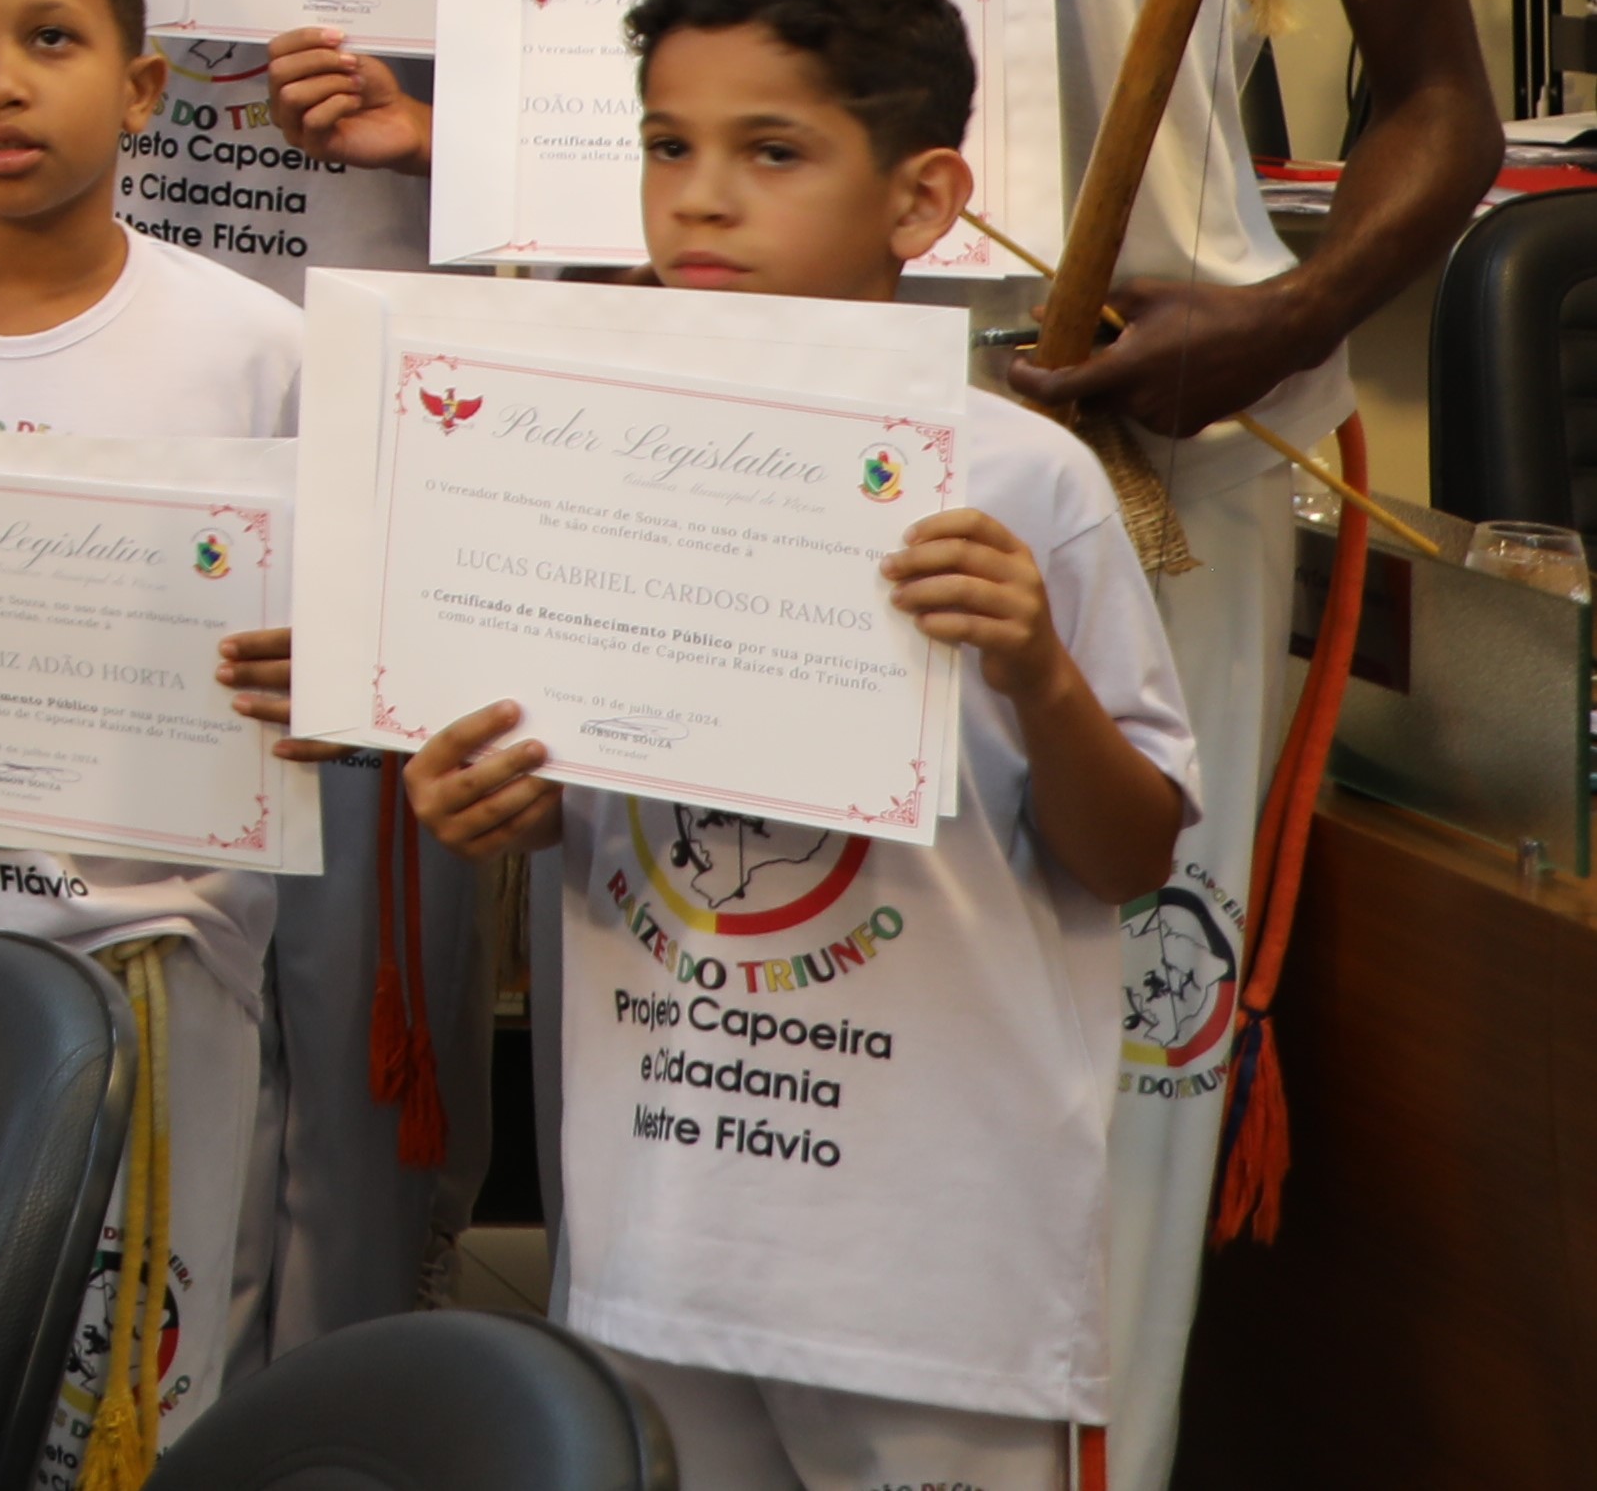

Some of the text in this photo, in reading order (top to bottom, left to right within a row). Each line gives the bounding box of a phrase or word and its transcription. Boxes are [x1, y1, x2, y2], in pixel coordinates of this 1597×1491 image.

[171, 100, 218, 130] DO
[522, 93, 584, 114] JOÃO
[121, 174, 306, 214] e Cidadania
[213, 223, 307, 258] Flávio
[492, 404, 829, 484] Poder Legislativo
[425, 479, 436, 490] O
[440, 482, 498, 500] Vereador
[503, 491, 551, 509] Robson
[556, 500, 609, 517] Alencar
[613, 508, 630, 520] de
[636, 511, 681, 530] Souza,
[688, 522, 706, 532] no
[711, 526, 737, 537] uso
[742, 528, 768, 542] das
[772, 535, 860, 556] atribuições
[539, 513, 560, 527] lhe
[565, 518, 588, 532] são
[592, 525, 672, 546] conferidas,
[677, 538, 740, 556] concede
[457, 548, 872, 631] LUCAS GABRIEL CARDOSO RAMOS
[433, 589, 512, 613] Certificado
[516, 603, 533, 617] de
[538, 607, 667, 639] Reconhecimento
[672, 629, 733, 650] Público
[738, 643, 766, 655] por
[772, 649, 798, 660] sua
[804, 653, 907, 677] participação
[438, 611, 475, 625] como
[479, 616, 518, 633] atleta
[523, 625, 540, 636] na
[545, 627, 627, 651] Associação
[632, 641, 650, 654] de
[656, 645, 727, 667] Capoeira
[789, 666, 810, 680] do
[28, 654, 94, 678] ADÃO
[102, 663, 185, 691] HORTA
[0, 864, 89, 900] Flávio
[607, 868, 904, 993] RAÍZES DO TRIUNFO
[615, 988, 892, 1060] Projeto Capoeira
[641, 1047, 841, 1108] e Cidadania
[715, 1115, 840, 1167] Flávio
